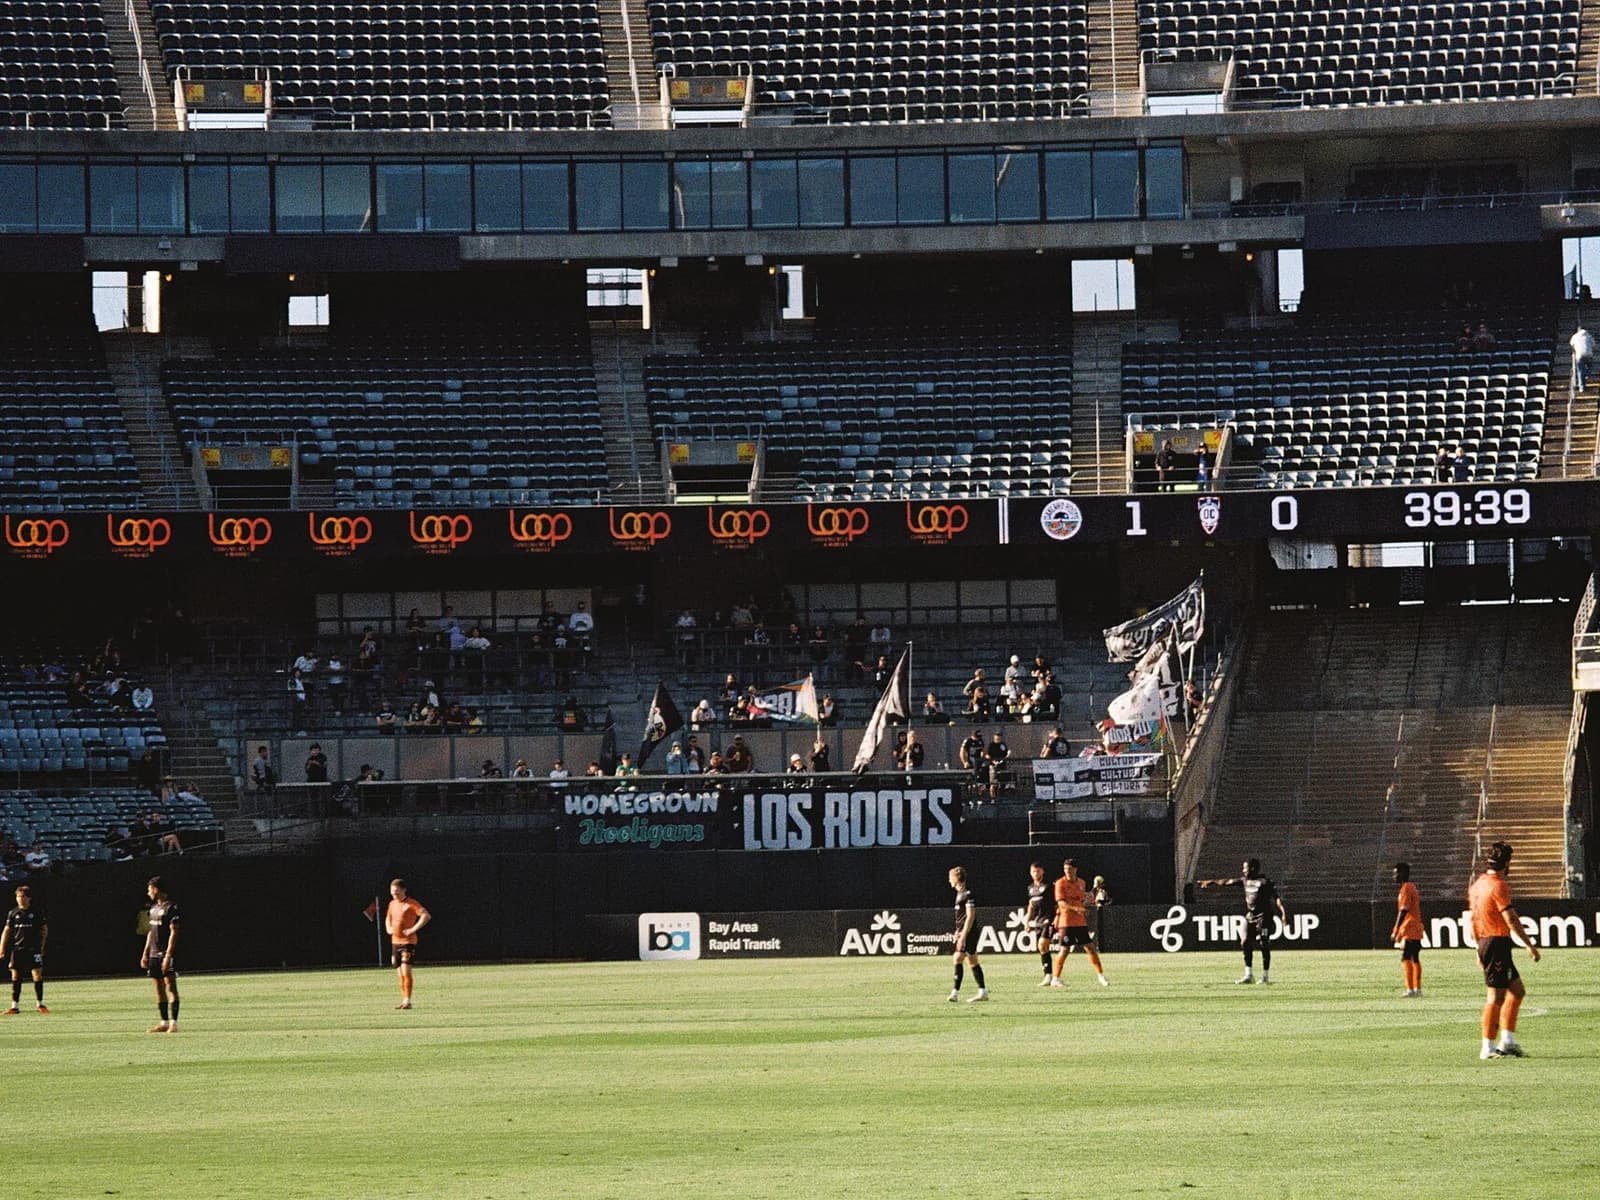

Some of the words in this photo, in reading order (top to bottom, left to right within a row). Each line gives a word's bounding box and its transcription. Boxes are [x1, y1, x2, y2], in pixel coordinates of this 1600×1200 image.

[1125, 501, 1147, 536] 1
[1271, 495, 1298, 531] 0
[1404, 488, 1531, 528] 39:39
[564, 791, 719, 815] HOMEGROWN
[579, 816, 705, 849] Hooligans
[743, 793, 813, 851] LOS
[823, 789, 953, 849] ROOTS
[708, 921, 730, 935] Bay
[731, 921, 759, 933] Area
[840, 928, 902, 955] Ava
[907, 932, 957, 943] Community
[976, 925, 1038, 953] Ava
[1393, 911, 1585, 949] ntem
[708, 938, 741, 952] Rapid
[743, 937, 781, 950] Transit
[907, 944, 939, 954] Energy
